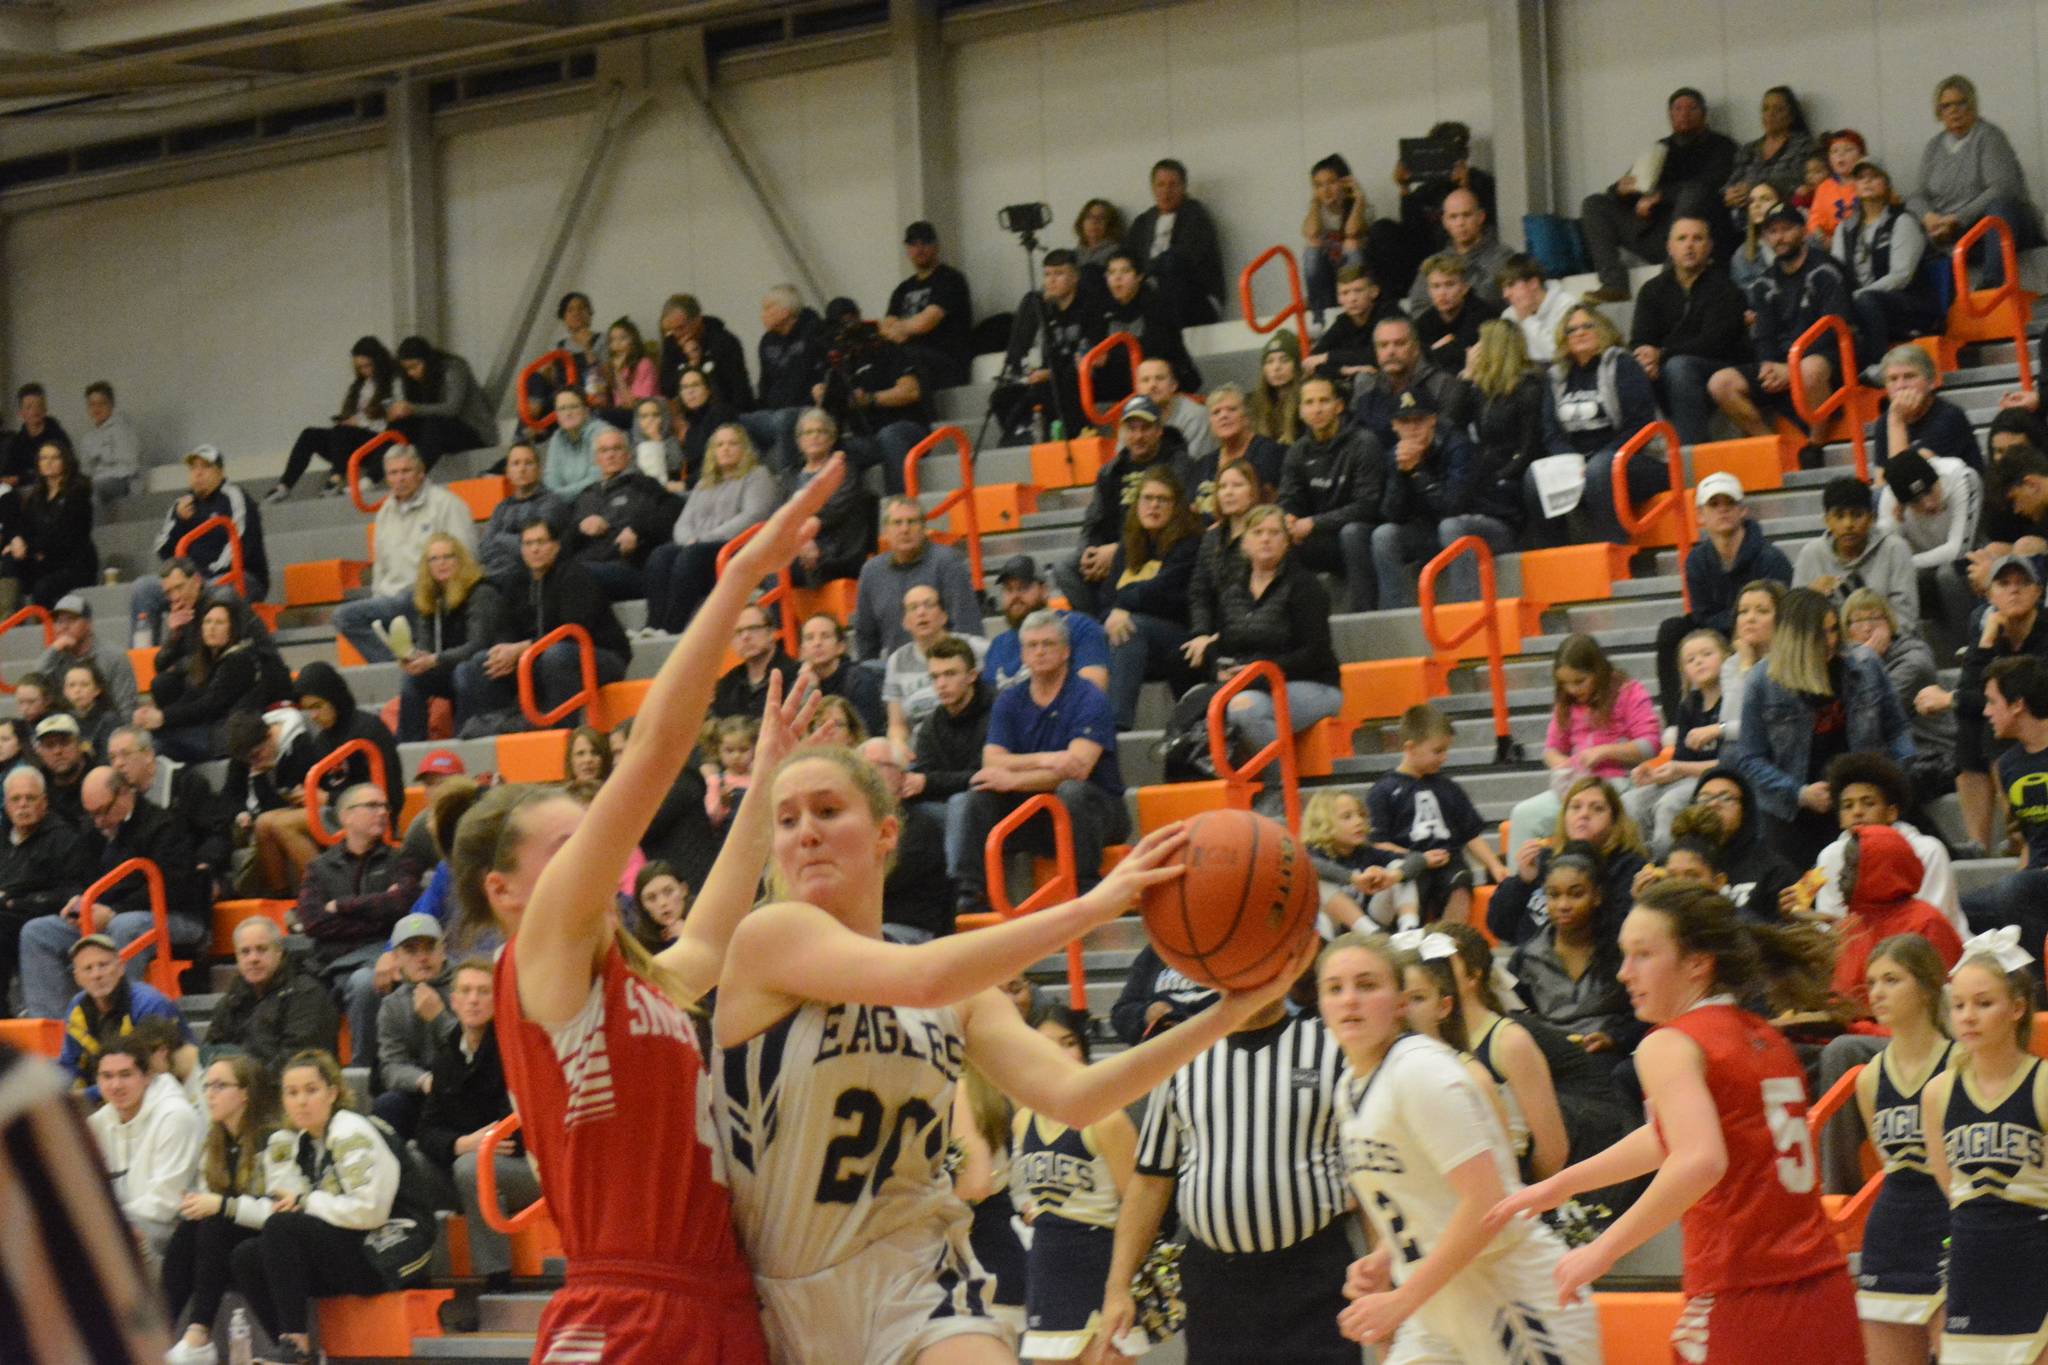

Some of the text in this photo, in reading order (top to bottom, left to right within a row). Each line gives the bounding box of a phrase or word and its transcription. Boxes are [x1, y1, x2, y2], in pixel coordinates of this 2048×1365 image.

[1408, 788, 1452, 842] A
[812, 1003, 966, 1084] EAGLES
[1760, 1076, 1817, 1193] 5
[1943, 1121, 2044, 1170] EAGLES
